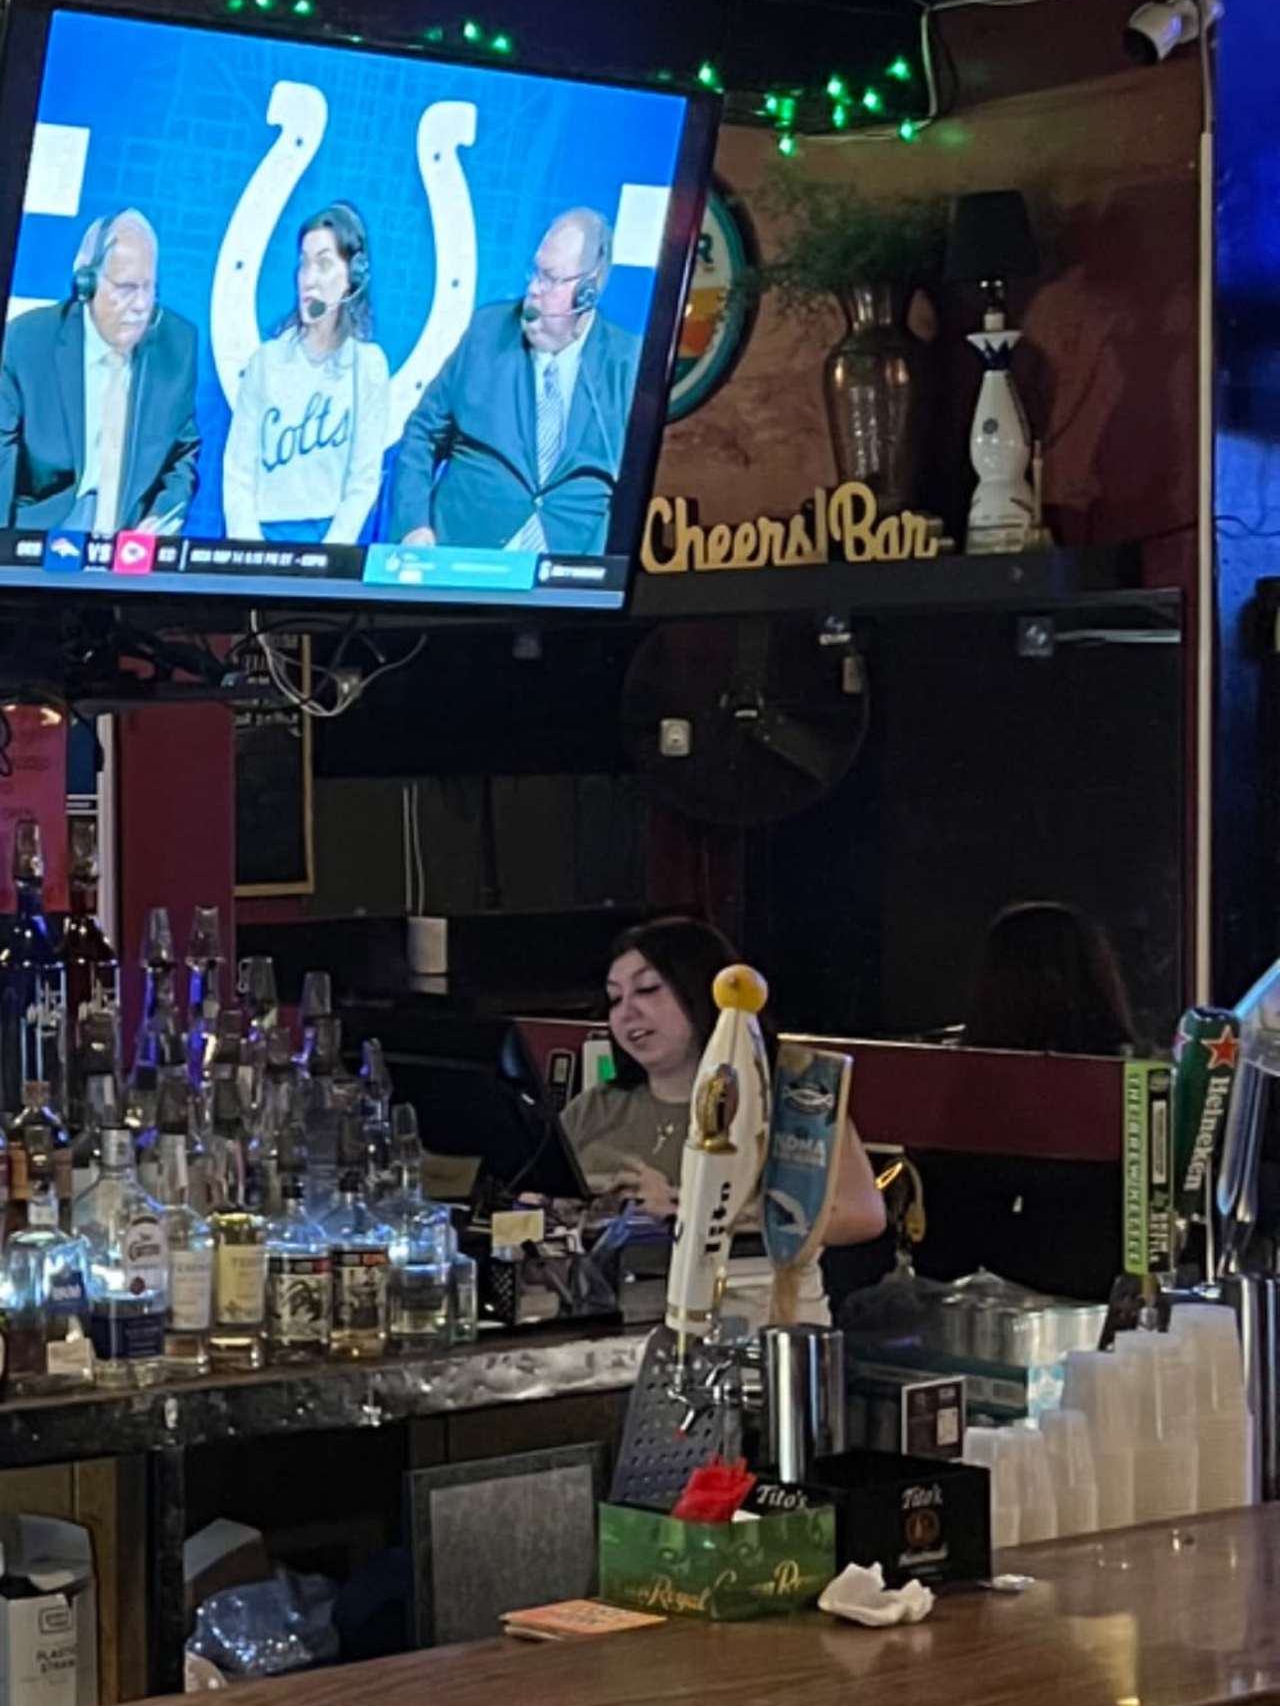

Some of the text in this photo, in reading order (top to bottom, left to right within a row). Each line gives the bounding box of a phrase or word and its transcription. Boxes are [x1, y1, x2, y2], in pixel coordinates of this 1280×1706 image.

[260, 394, 352, 471] Colts
[828, 481, 954, 563] Bar
[1183, 1074, 1231, 1192] Heineken
[756, 1483, 808, 1510] Tito's
